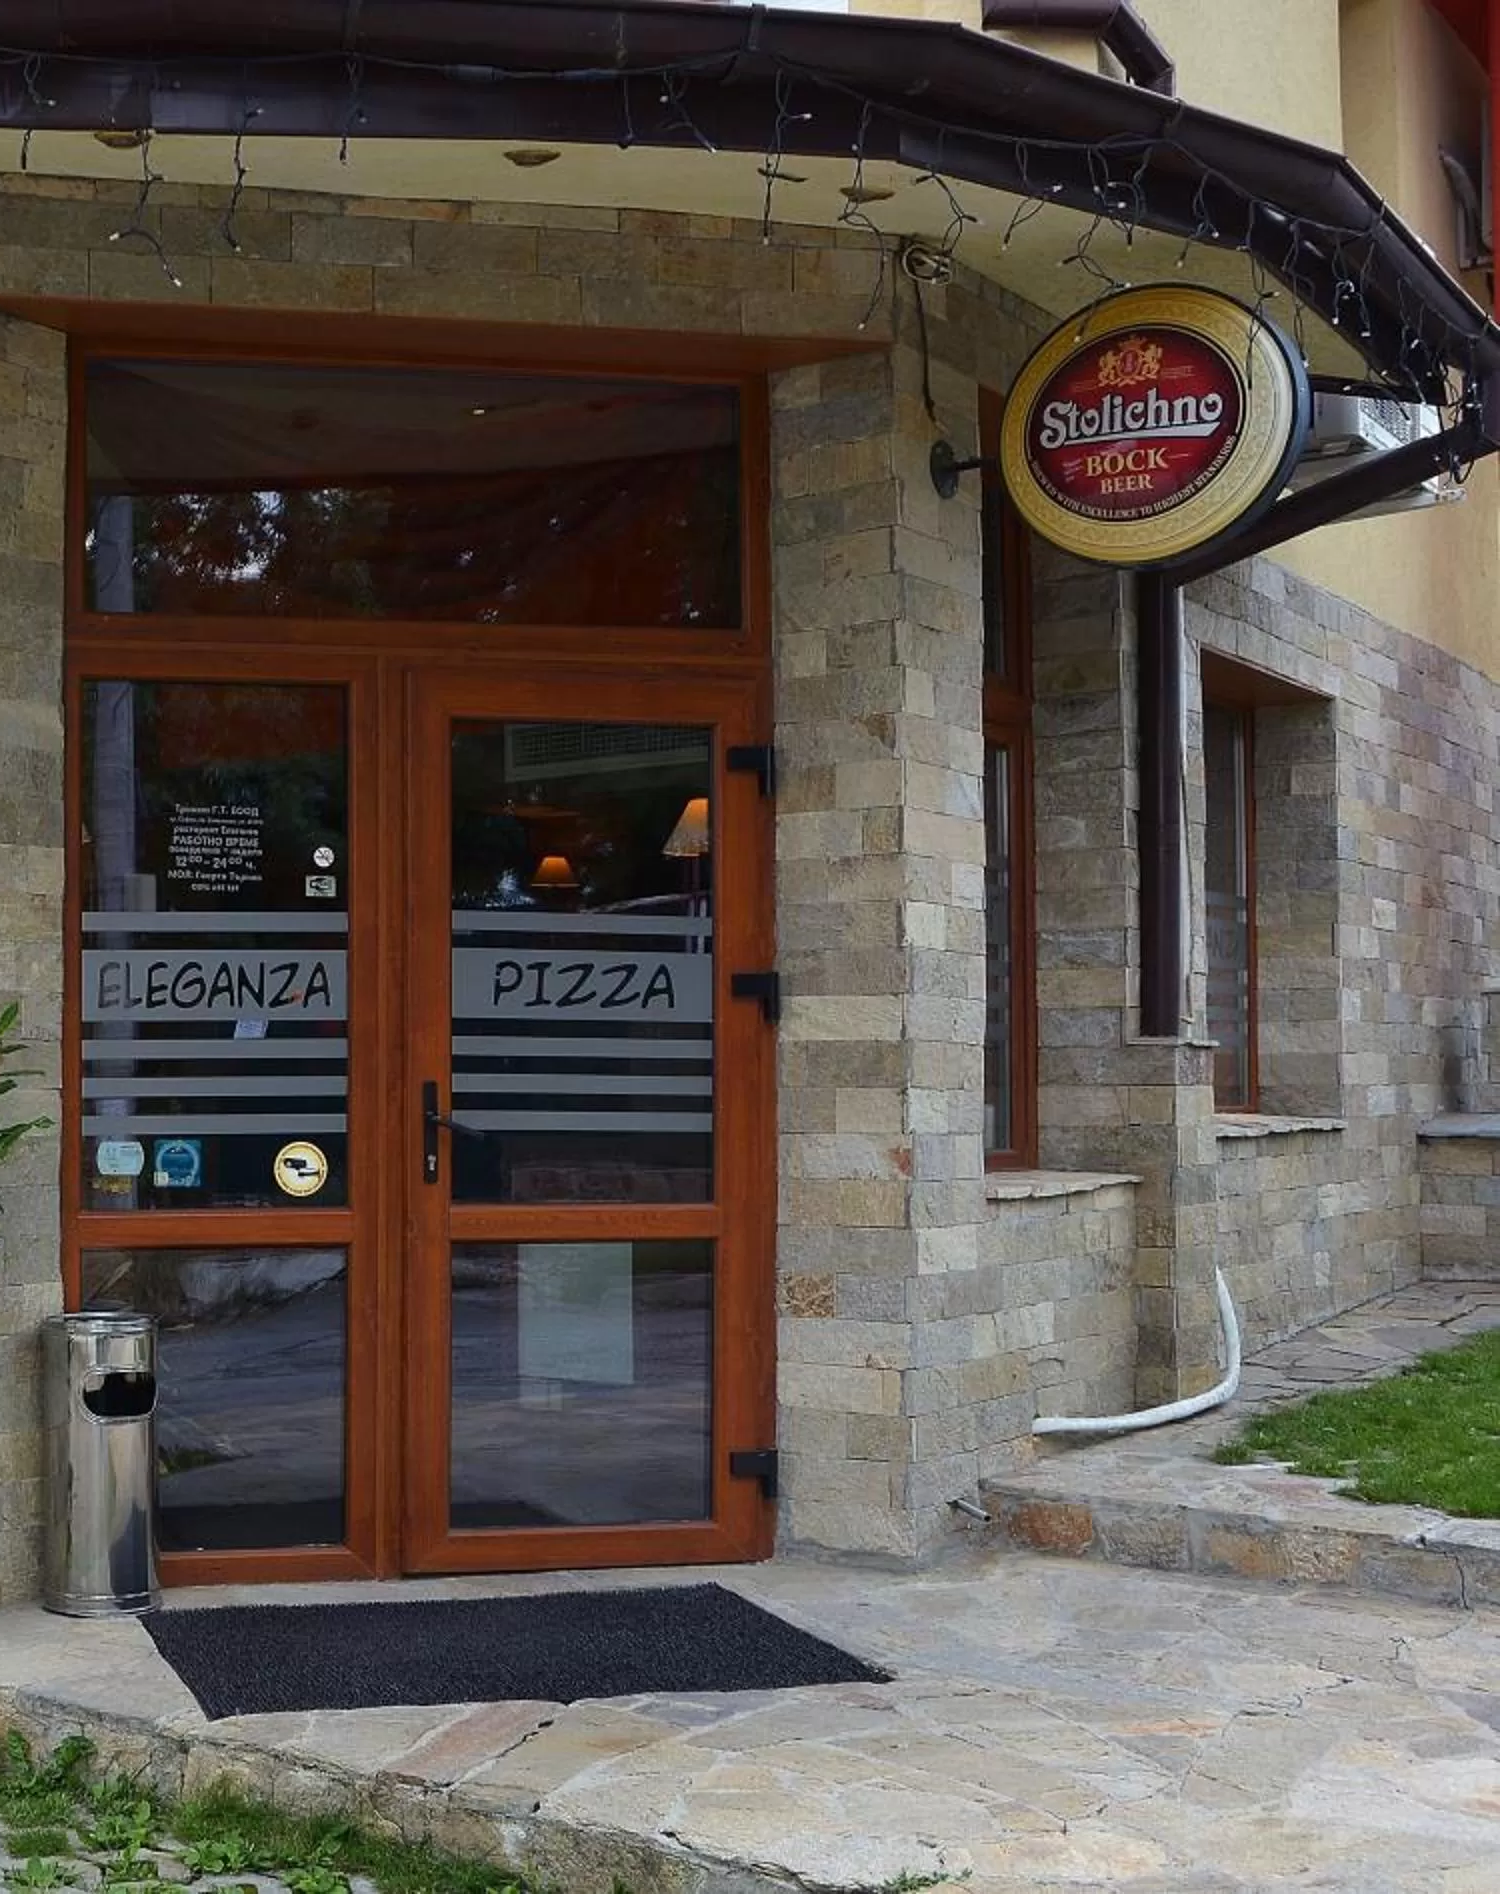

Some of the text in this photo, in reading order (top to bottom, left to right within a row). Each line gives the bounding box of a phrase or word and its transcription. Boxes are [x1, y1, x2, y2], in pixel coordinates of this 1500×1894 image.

[1039, 387, 1223, 449] Stolichno
[1056, 489, 1080, 512] WITH
[1080, 503, 1139, 520] EXCELLENCE
[1140, 504, 1153, 517] TO
[1153, 486, 1197, 513] HIGHEST
[1193, 434, 1238, 489] STANDARDS
[1085, 447, 1170, 478] BOCK
[1100, 474, 1154, 495] BEER
[173, 835, 259, 848] РАБОТНО ВРЕМЕ
[97, 960, 331, 1010] ELEGANZA
[492, 960, 676, 1009] PIZZA
